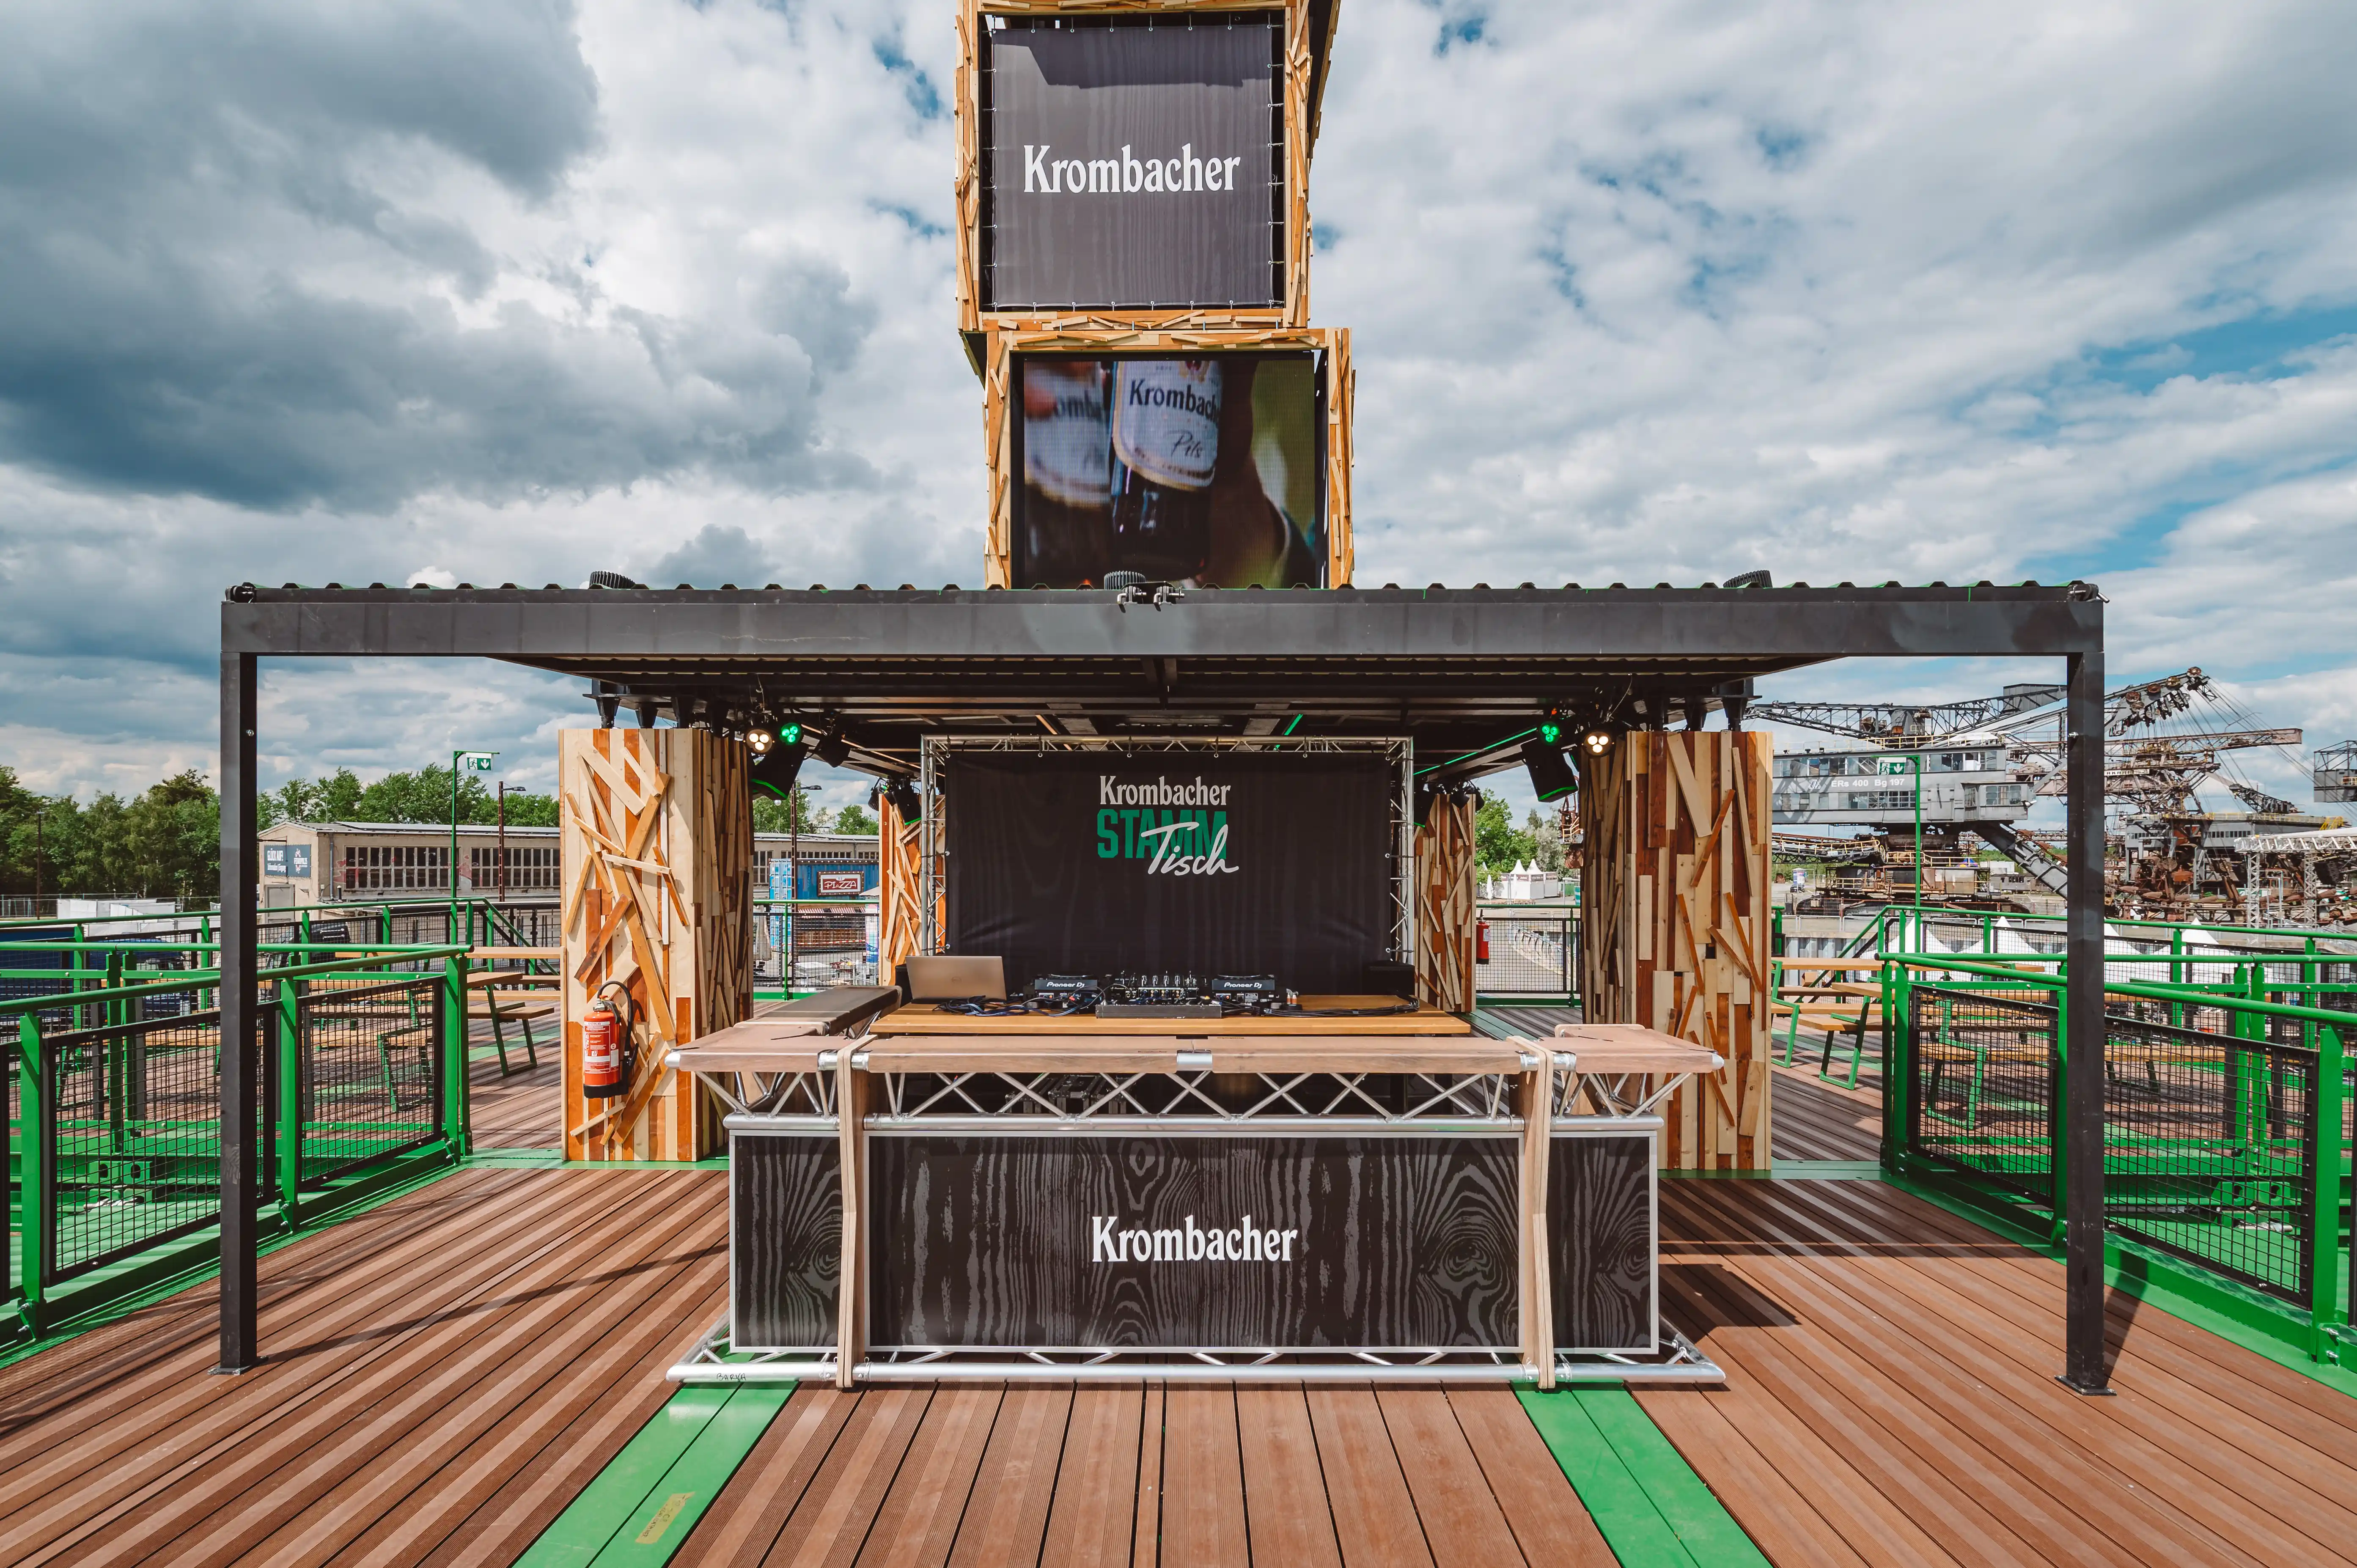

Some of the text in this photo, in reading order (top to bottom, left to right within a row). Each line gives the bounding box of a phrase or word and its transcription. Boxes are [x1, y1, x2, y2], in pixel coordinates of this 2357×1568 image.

[1024, 143, 1240, 193] Krombacher
[1100, 775, 1231, 806] Krombacher
[1874, 779, 1887, 788] Bg
[1097, 808, 1227, 859] STAMM
[1140, 821, 1239, 876] Tisch
[1091, 1214, 1298, 1262] Krombacher
